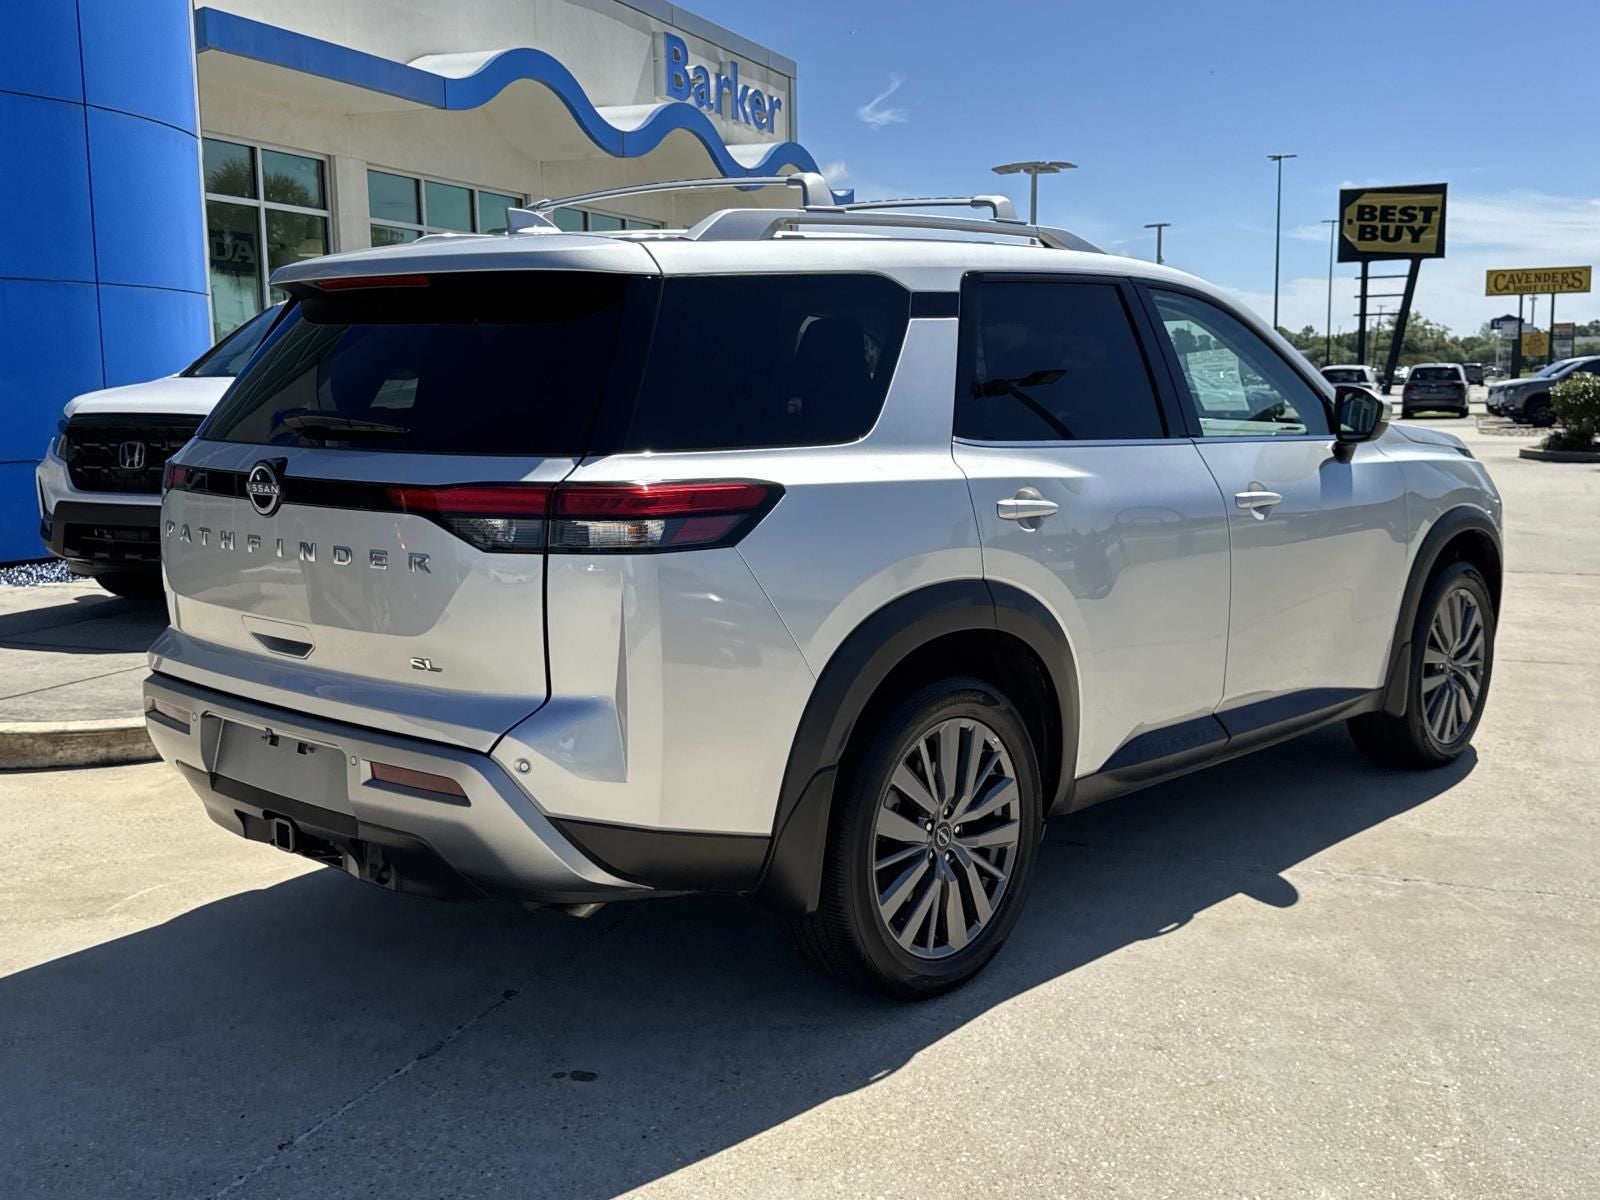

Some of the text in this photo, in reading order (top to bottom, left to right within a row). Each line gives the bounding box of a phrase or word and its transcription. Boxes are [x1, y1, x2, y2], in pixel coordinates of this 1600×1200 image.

[664, 31, 782, 134] Barker
[1356, 204, 1438, 224] BEST
[1357, 224, 1429, 243] BUY
[1493, 270, 1583, 291] CAVENDER'S
[246, 482, 280, 494] NISSAN
[165, 519, 433, 574] PATHFINDER
[408, 657, 443, 672] SL
